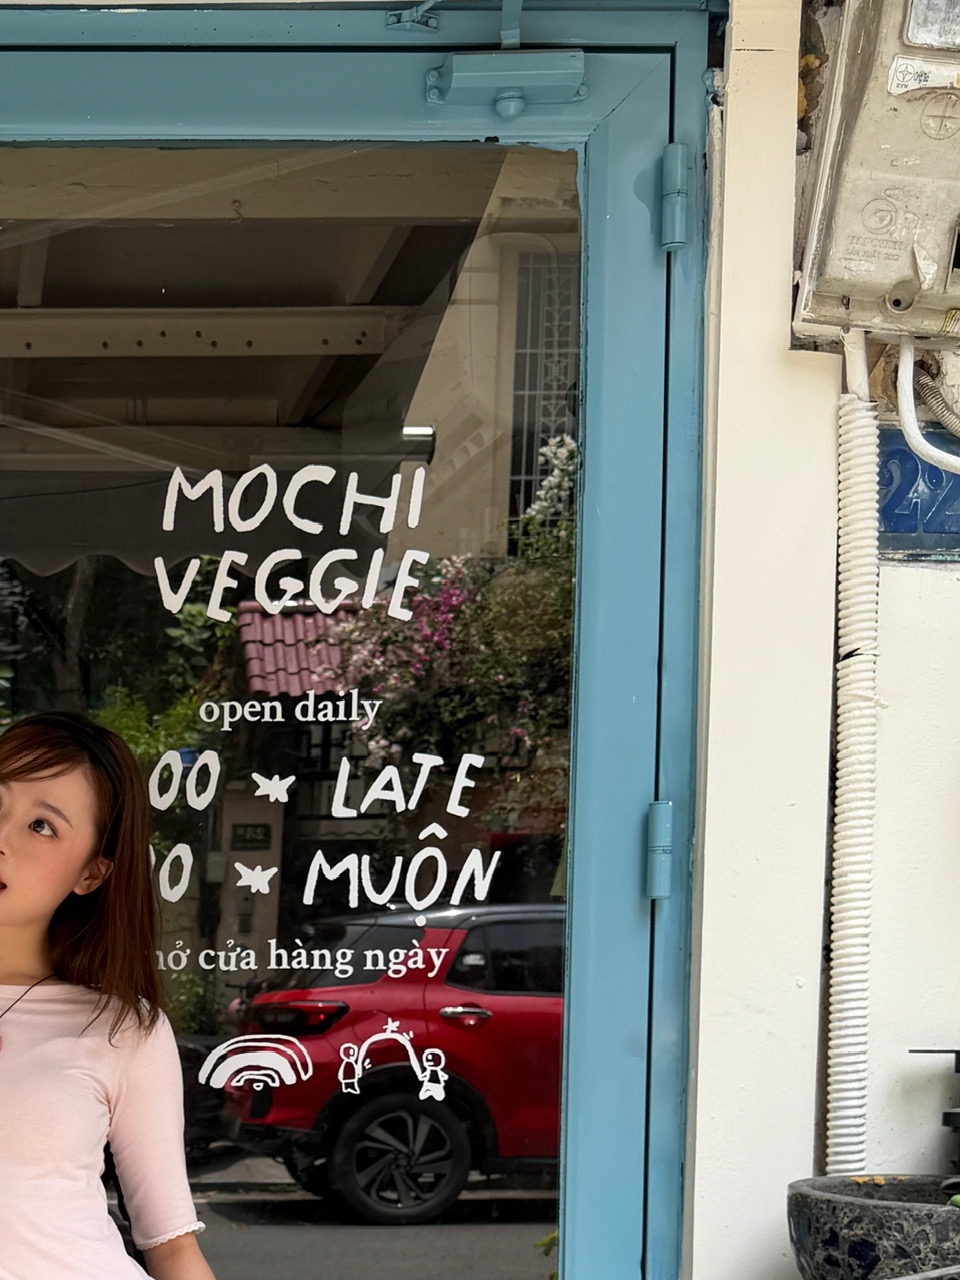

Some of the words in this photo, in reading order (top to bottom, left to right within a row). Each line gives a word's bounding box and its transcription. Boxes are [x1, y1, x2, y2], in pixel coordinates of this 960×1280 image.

[162, 463, 426, 536] MOCHI
[154, 547, 430, 622] VEGGIE
[198, 699, 285, 731] open
[294, 688, 383, 731] daily
[331, 753, 485, 818] LATE
[148, 843, 194, 903] 0
[302, 822, 502, 927] MUỘN
[198, 939, 258, 972] cửa
[267, 938, 355, 978] hàng
[362, 938, 451, 978] ngày
